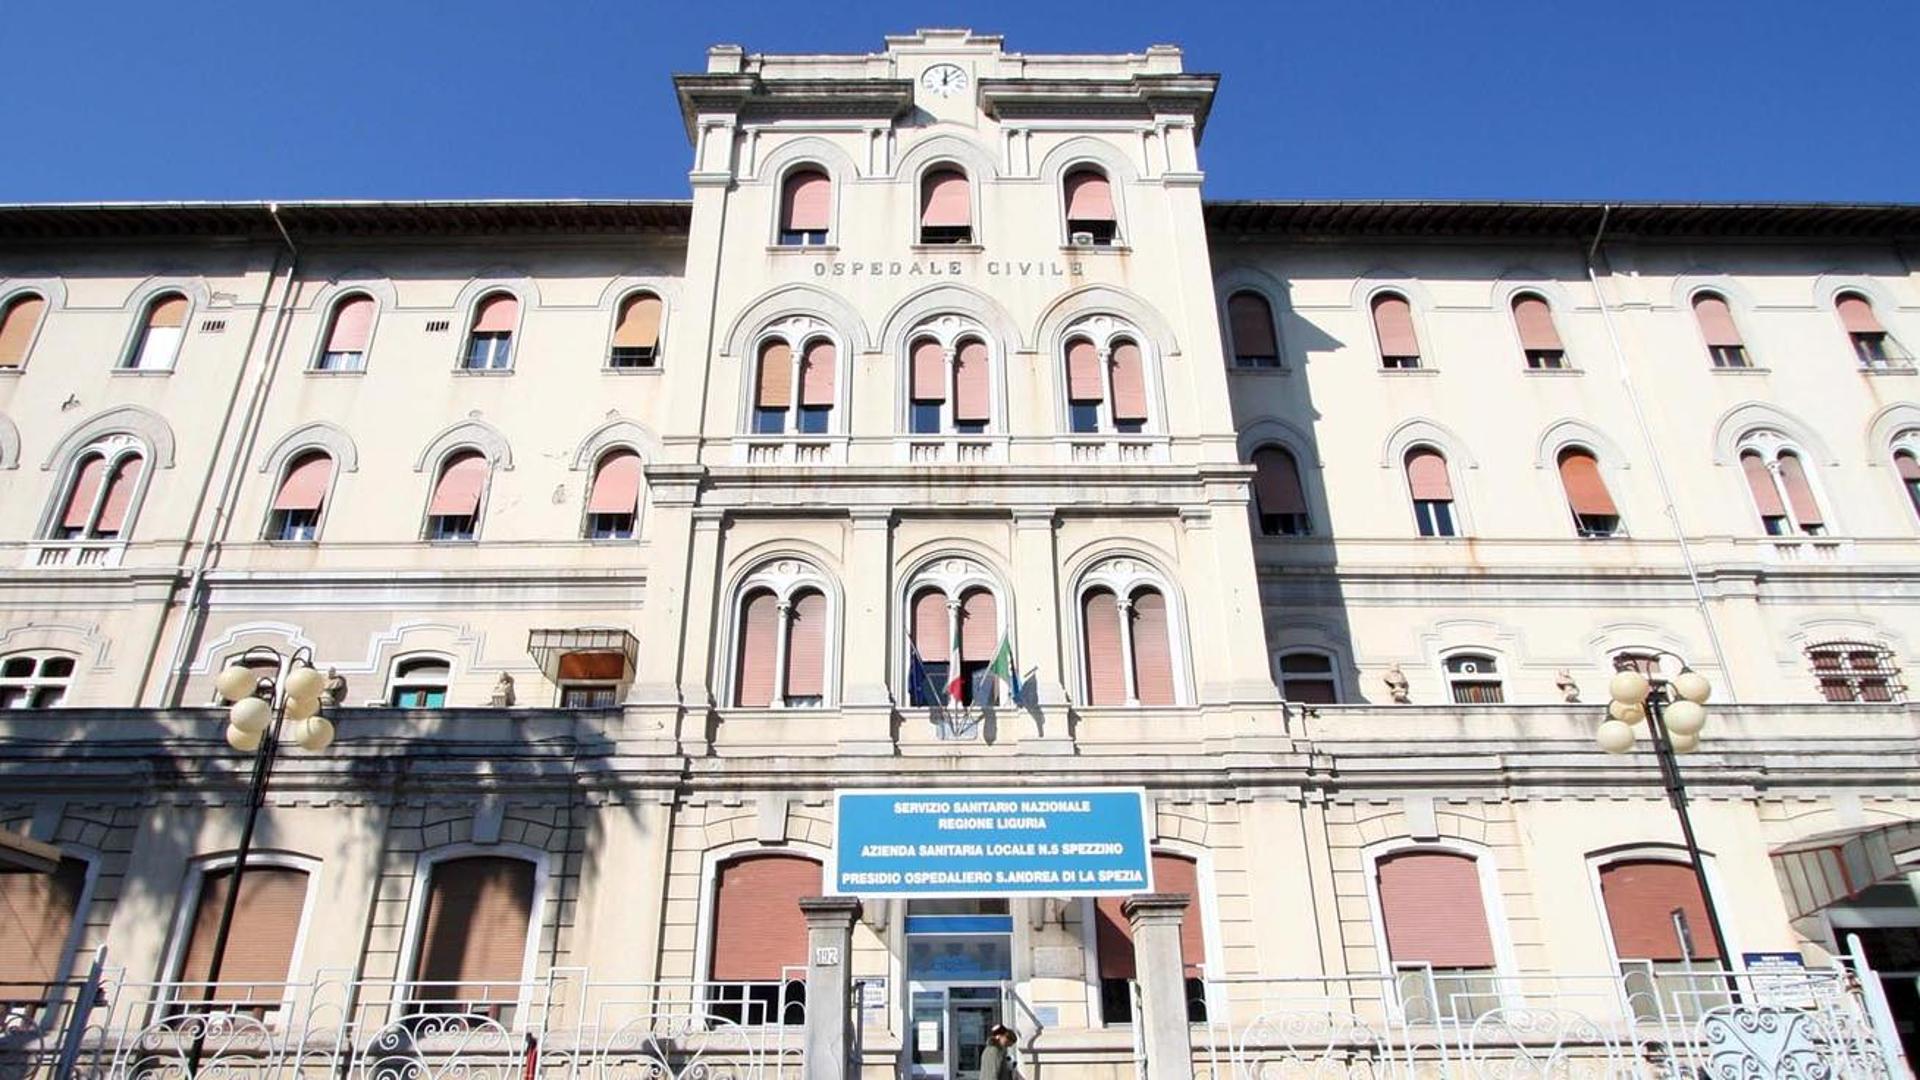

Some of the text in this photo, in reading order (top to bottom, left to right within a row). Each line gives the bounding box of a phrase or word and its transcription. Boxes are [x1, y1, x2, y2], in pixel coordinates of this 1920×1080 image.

[814, 262, 1083, 276] OSPEDALE CIVILE
[894, 801, 1091, 814] SERVIZIO SANITARIO NAZIONALE
[938, 817, 1047, 830] REGIONE LIGURIA
[861, 845, 916, 857] AZIENDA
[919, 845, 983, 856] SANITARIA
[987, 844, 1035, 856] LOCALE
[1062, 843, 1123, 855] SPEZZINO
[842, 870, 1143, 885] PRESIDIO OSPEDALIERO S.ANDREA DI LA SPEZIA
